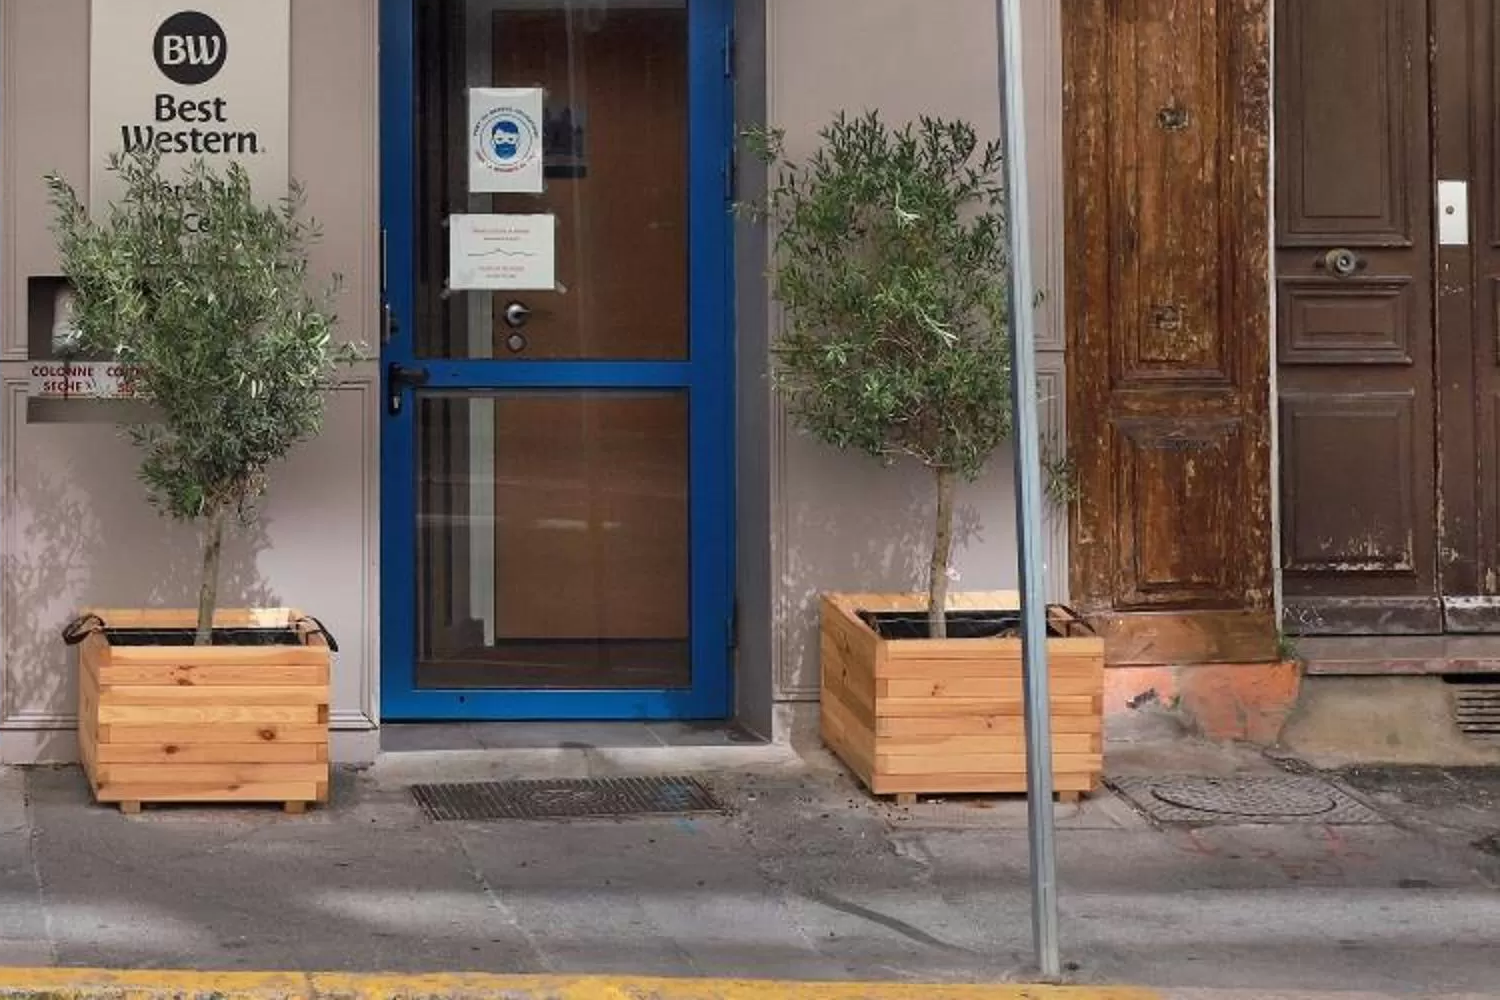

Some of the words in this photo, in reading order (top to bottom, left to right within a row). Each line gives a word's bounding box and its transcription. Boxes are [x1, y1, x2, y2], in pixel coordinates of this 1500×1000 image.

[162, 35, 221, 65] BW
[155, 93, 227, 122] Best
[121, 125, 258, 154] Western
[31, 366, 94, 377] COLONNE
